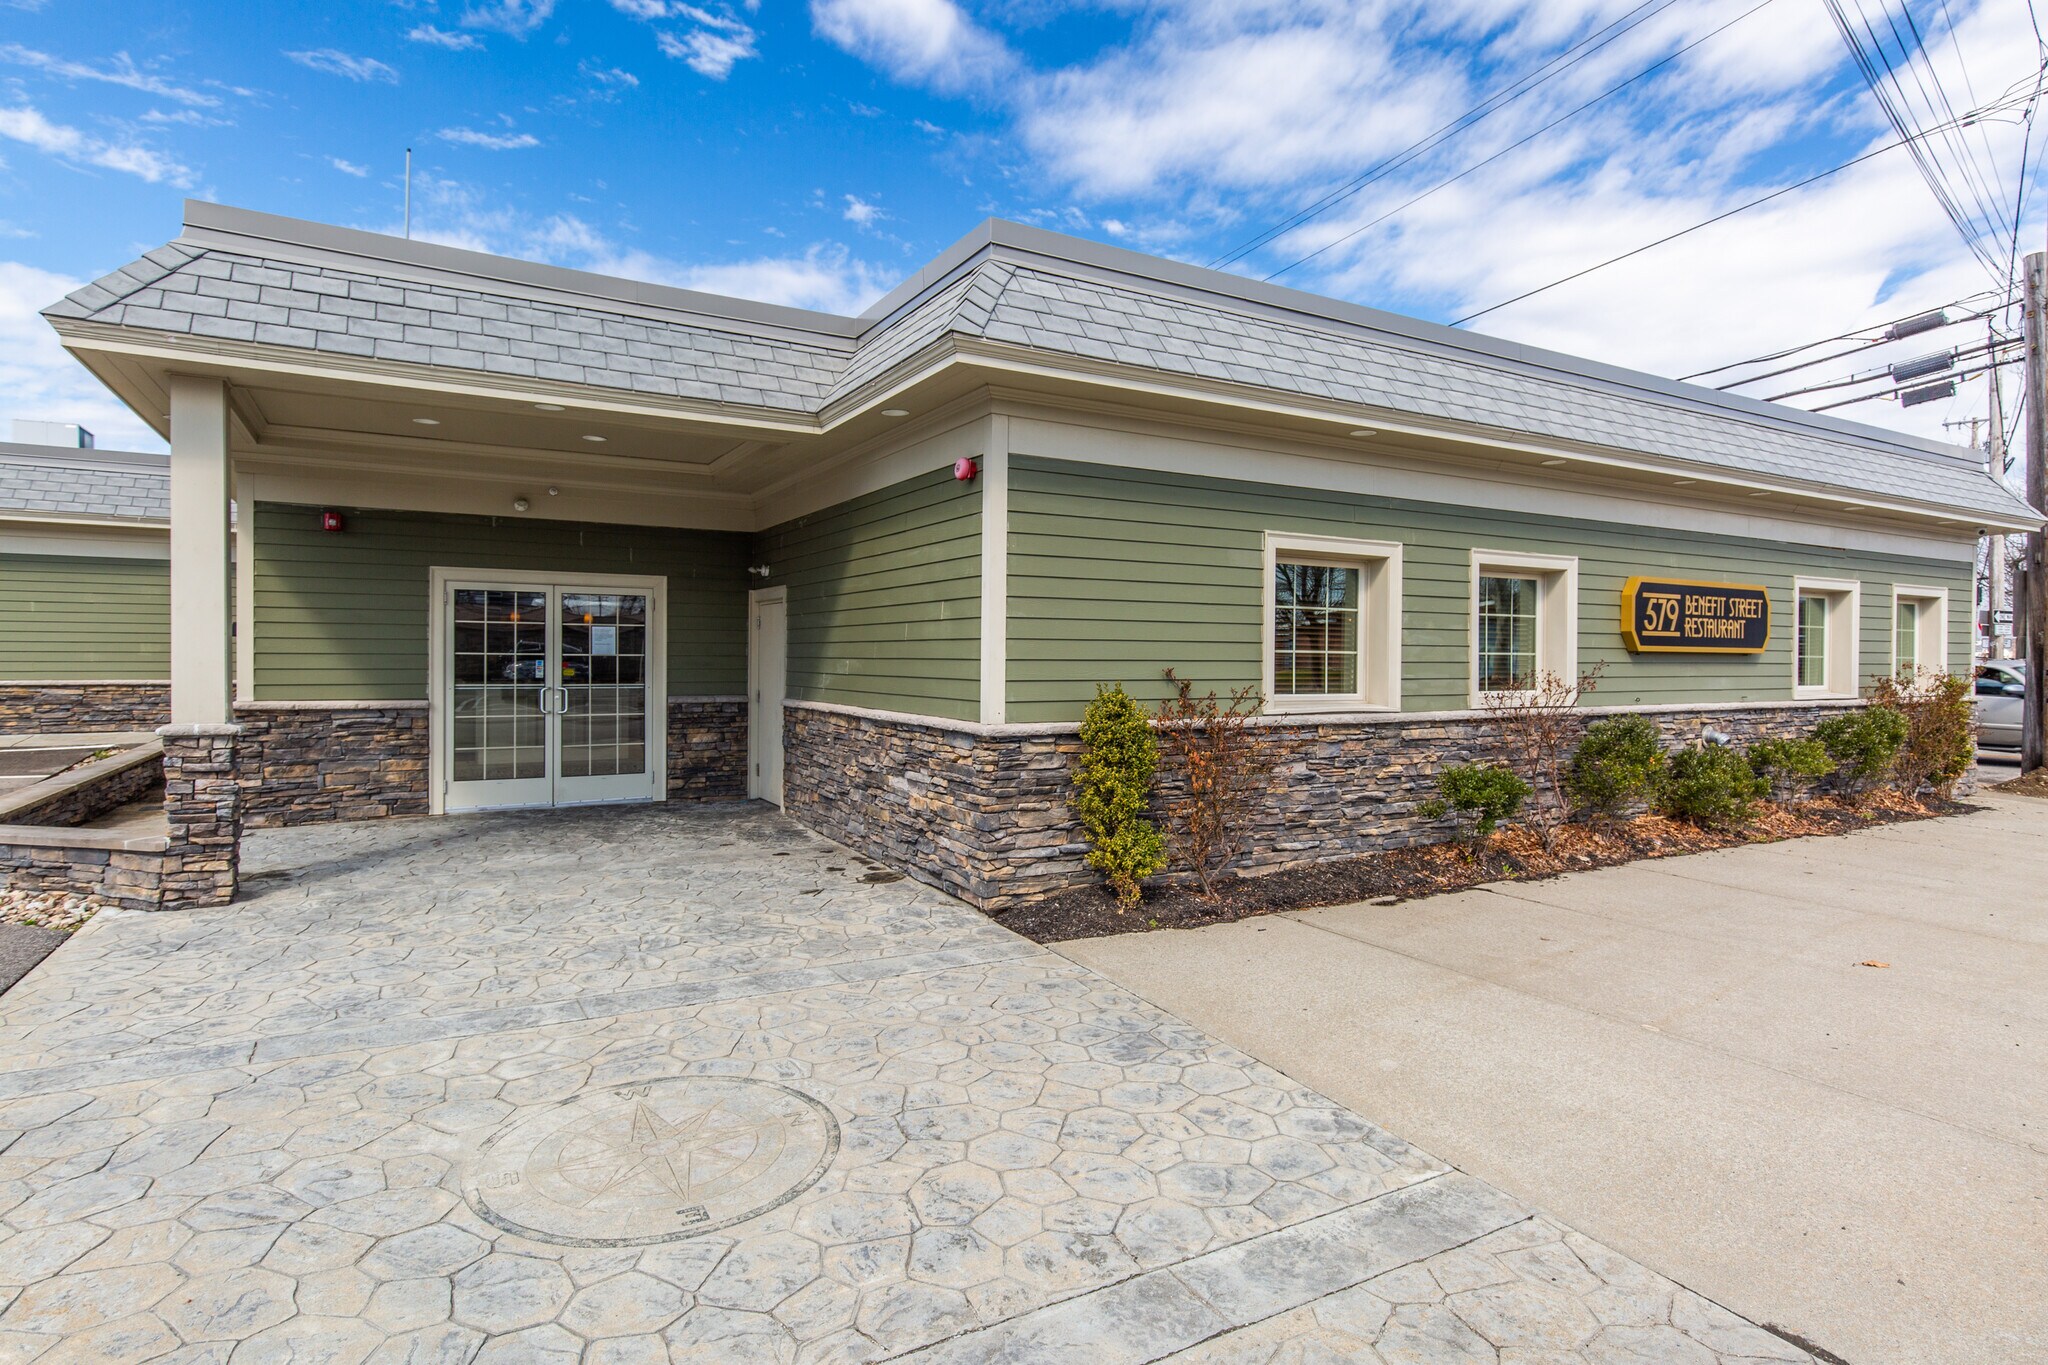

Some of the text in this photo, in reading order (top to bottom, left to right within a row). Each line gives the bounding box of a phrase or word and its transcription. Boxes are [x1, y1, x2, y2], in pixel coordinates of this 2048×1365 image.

[1644, 598, 1679, 631] 579
[1685, 595, 1763, 618] BENEFIT STREET
[1684, 618, 1746, 639] RESTAURANT
[614, 1085, 651, 1101] W
[676, 1205, 710, 1227] E
